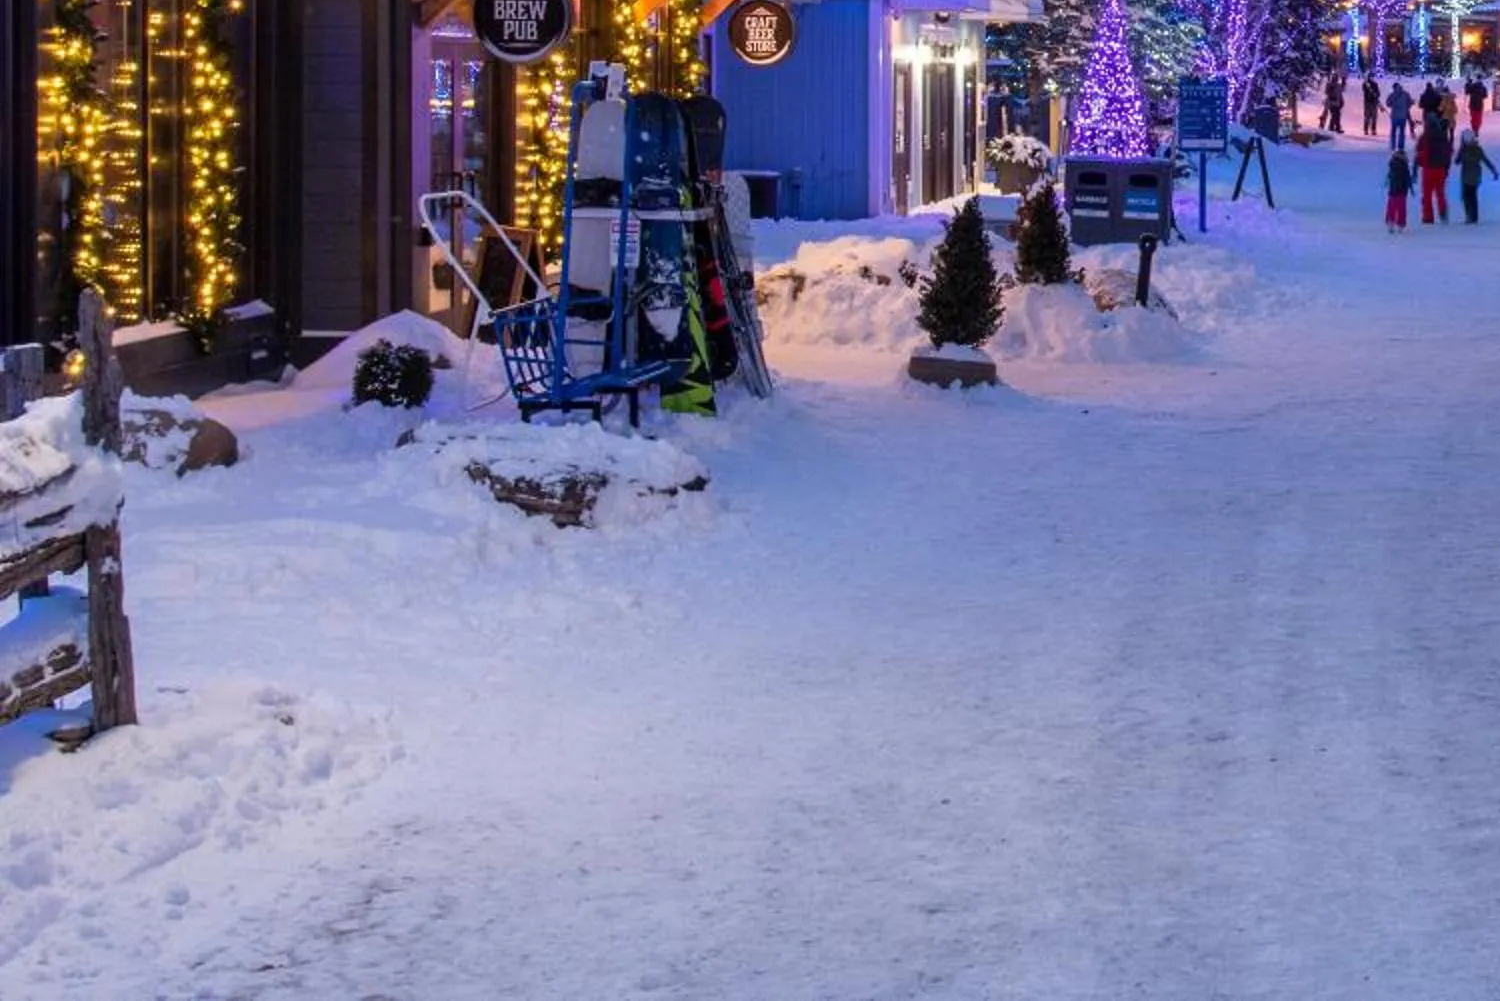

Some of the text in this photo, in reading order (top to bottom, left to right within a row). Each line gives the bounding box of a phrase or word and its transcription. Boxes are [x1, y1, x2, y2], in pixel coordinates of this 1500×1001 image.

[494, 0, 547, 20] BREW
[745, 16, 778, 29] CRAFT
[503, 20, 537, 40] PUB
[748, 29, 775, 40] BEER
[745, 40, 777, 52] STORE
